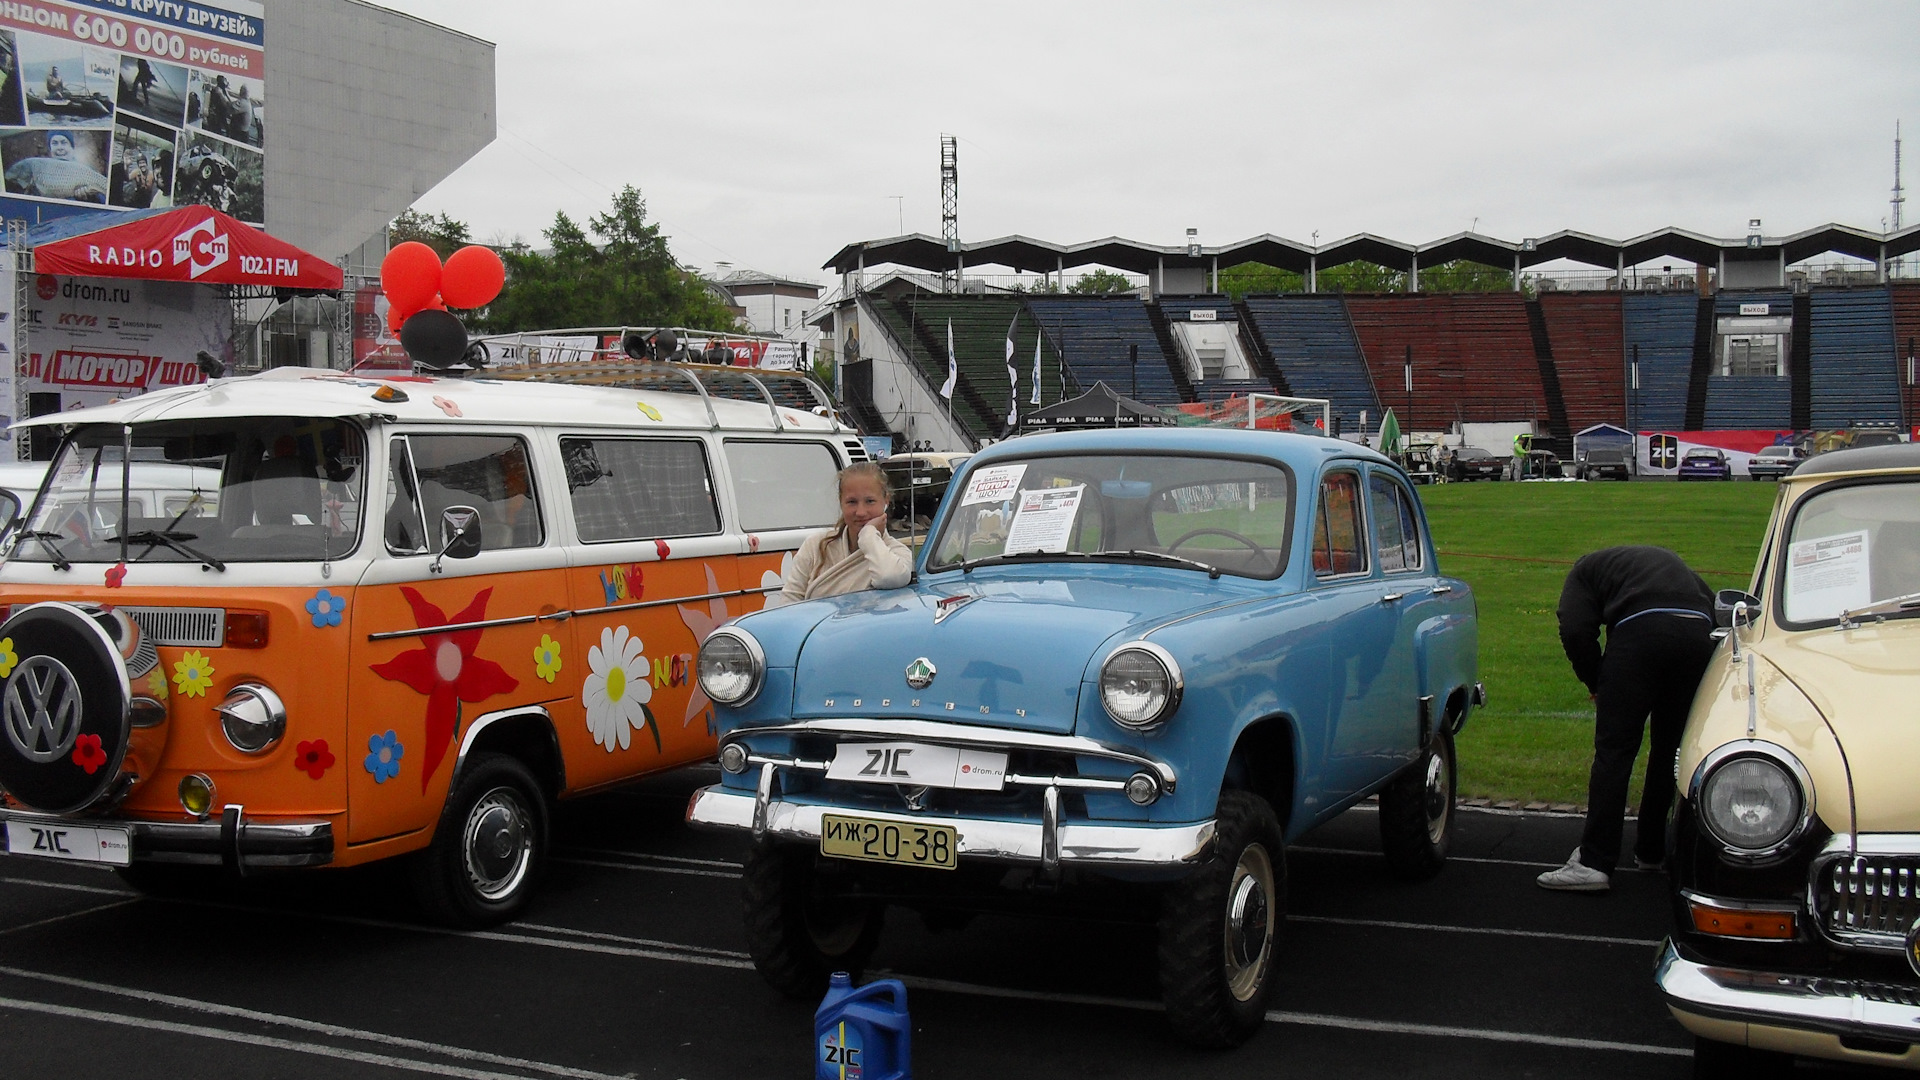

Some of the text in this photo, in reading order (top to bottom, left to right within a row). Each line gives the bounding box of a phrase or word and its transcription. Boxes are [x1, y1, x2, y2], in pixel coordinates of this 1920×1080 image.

[131, 0, 184, 20] КРУГУ
[0, 1, 248, 70] НДОМ 600 000 рублей
[1191, 245, 1199, 256] 2
[1526, 239, 1533, 250] 3
[1751, 236, 1758, 247] 4
[89, 245, 163, 268] RADIO
[240, 255, 272, 275] 102.1
[276, 259, 298, 276] FM
[62, 277, 131, 303] drom.ru
[58, 354, 145, 384] МОТОР
[1652, 447, 1675, 458] ZIC
[654, 654, 692, 690] NOT
[858, 748, 1003, 778] ZIC drom.ru
[29, 827, 127, 855] ZIC drom.ru
[824, 1044, 860, 1067] ZIC
